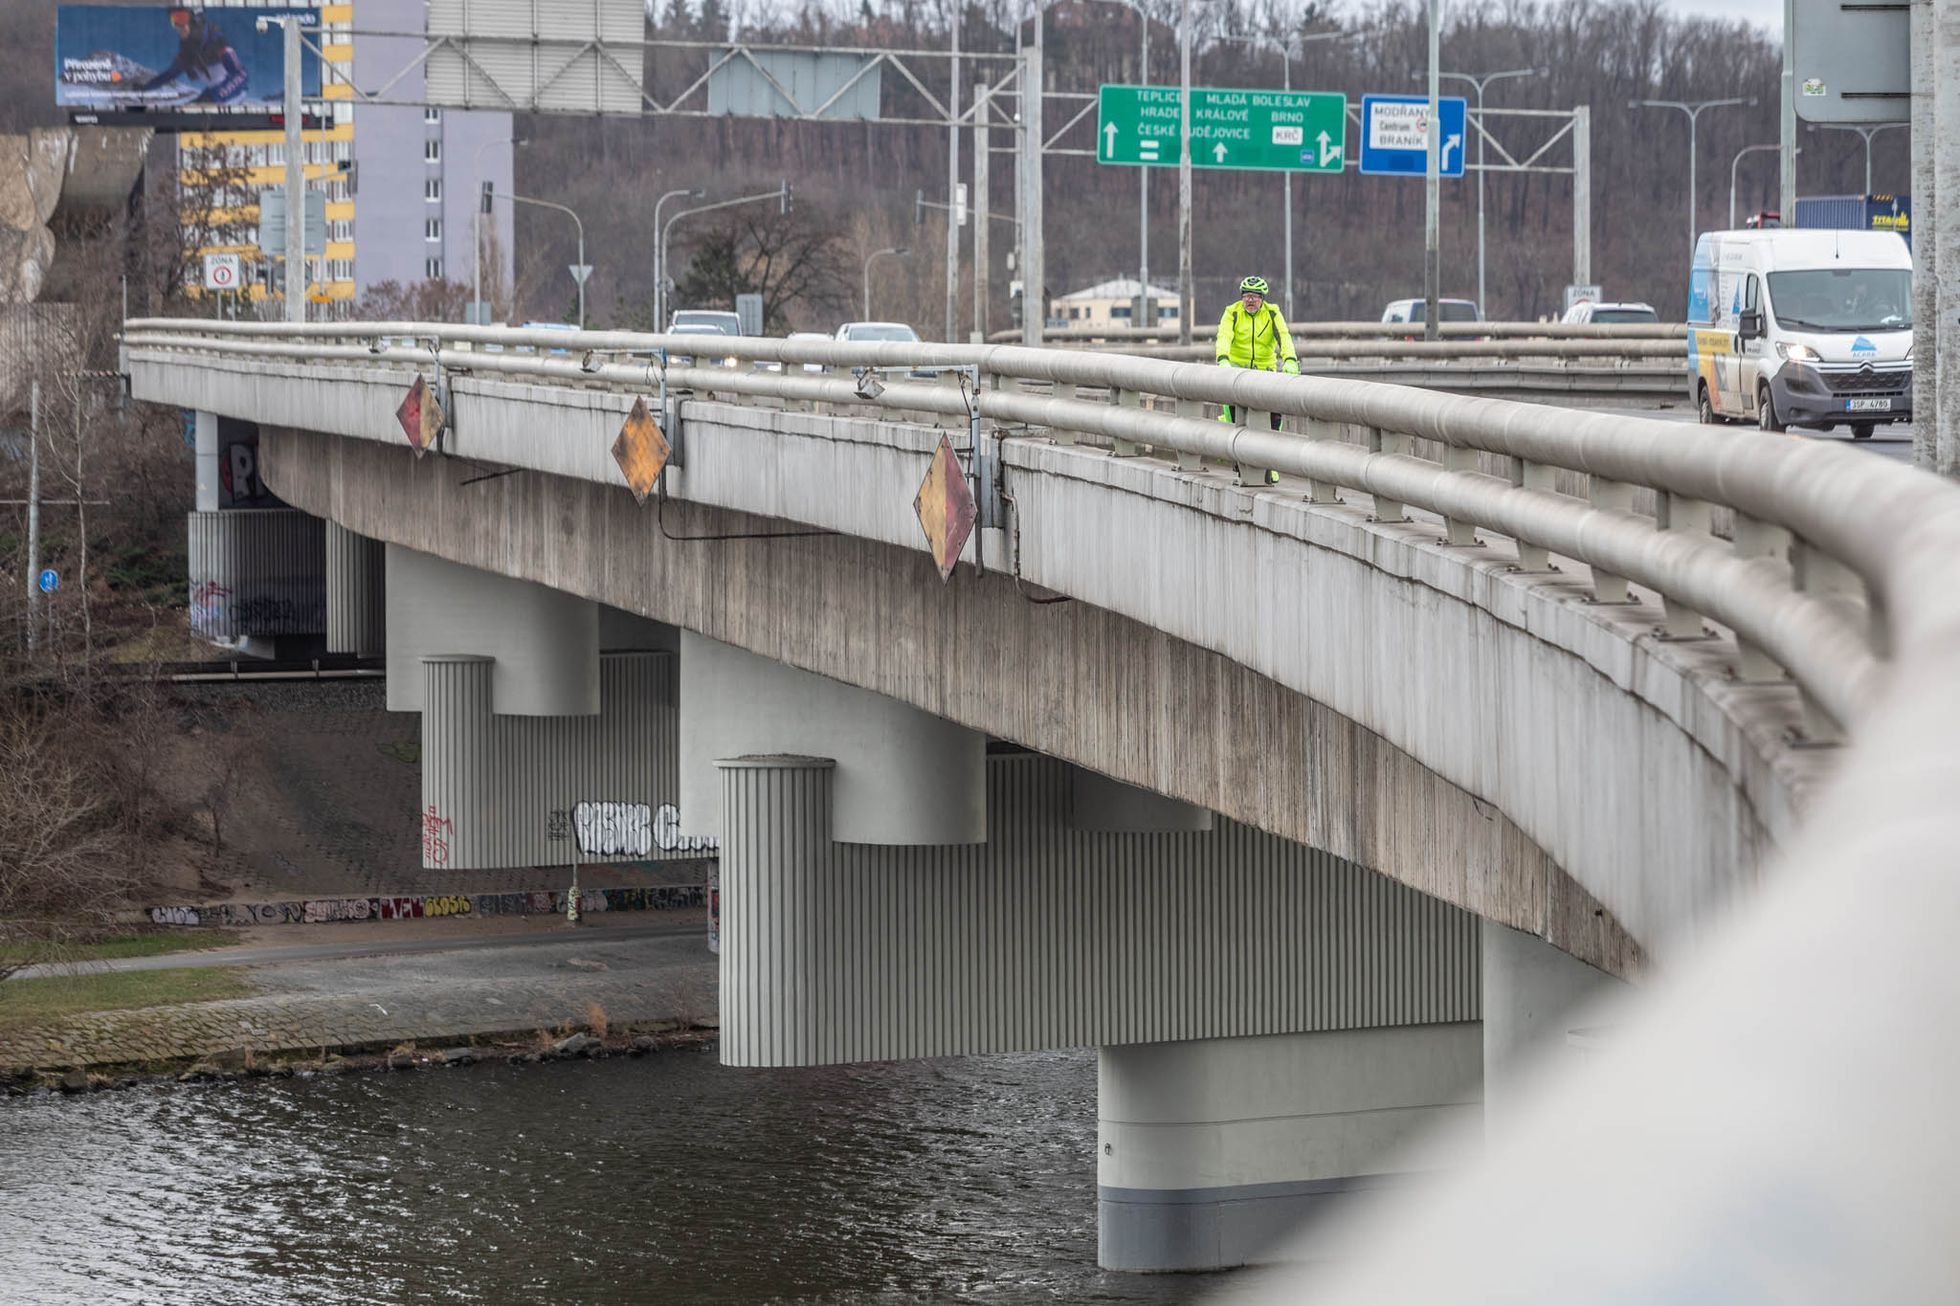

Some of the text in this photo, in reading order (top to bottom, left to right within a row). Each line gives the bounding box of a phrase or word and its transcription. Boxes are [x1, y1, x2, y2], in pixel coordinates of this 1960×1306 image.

[1137, 90, 1183, 103] TEPLICE
[1206, 92, 1312, 108] MLADÁ BOLESLAV
[1140, 106, 1249, 122] HRADE KRÁLOVÉ
[1271, 111, 1304, 123] BRNO
[1137, 121, 1251, 140] ČESKÉ UDĚJOVICE
[1379, 120, 1411, 132] Centrum
[1275, 128, 1299, 141] KRČ
[1379, 133, 1424, 146] BRANÍK
